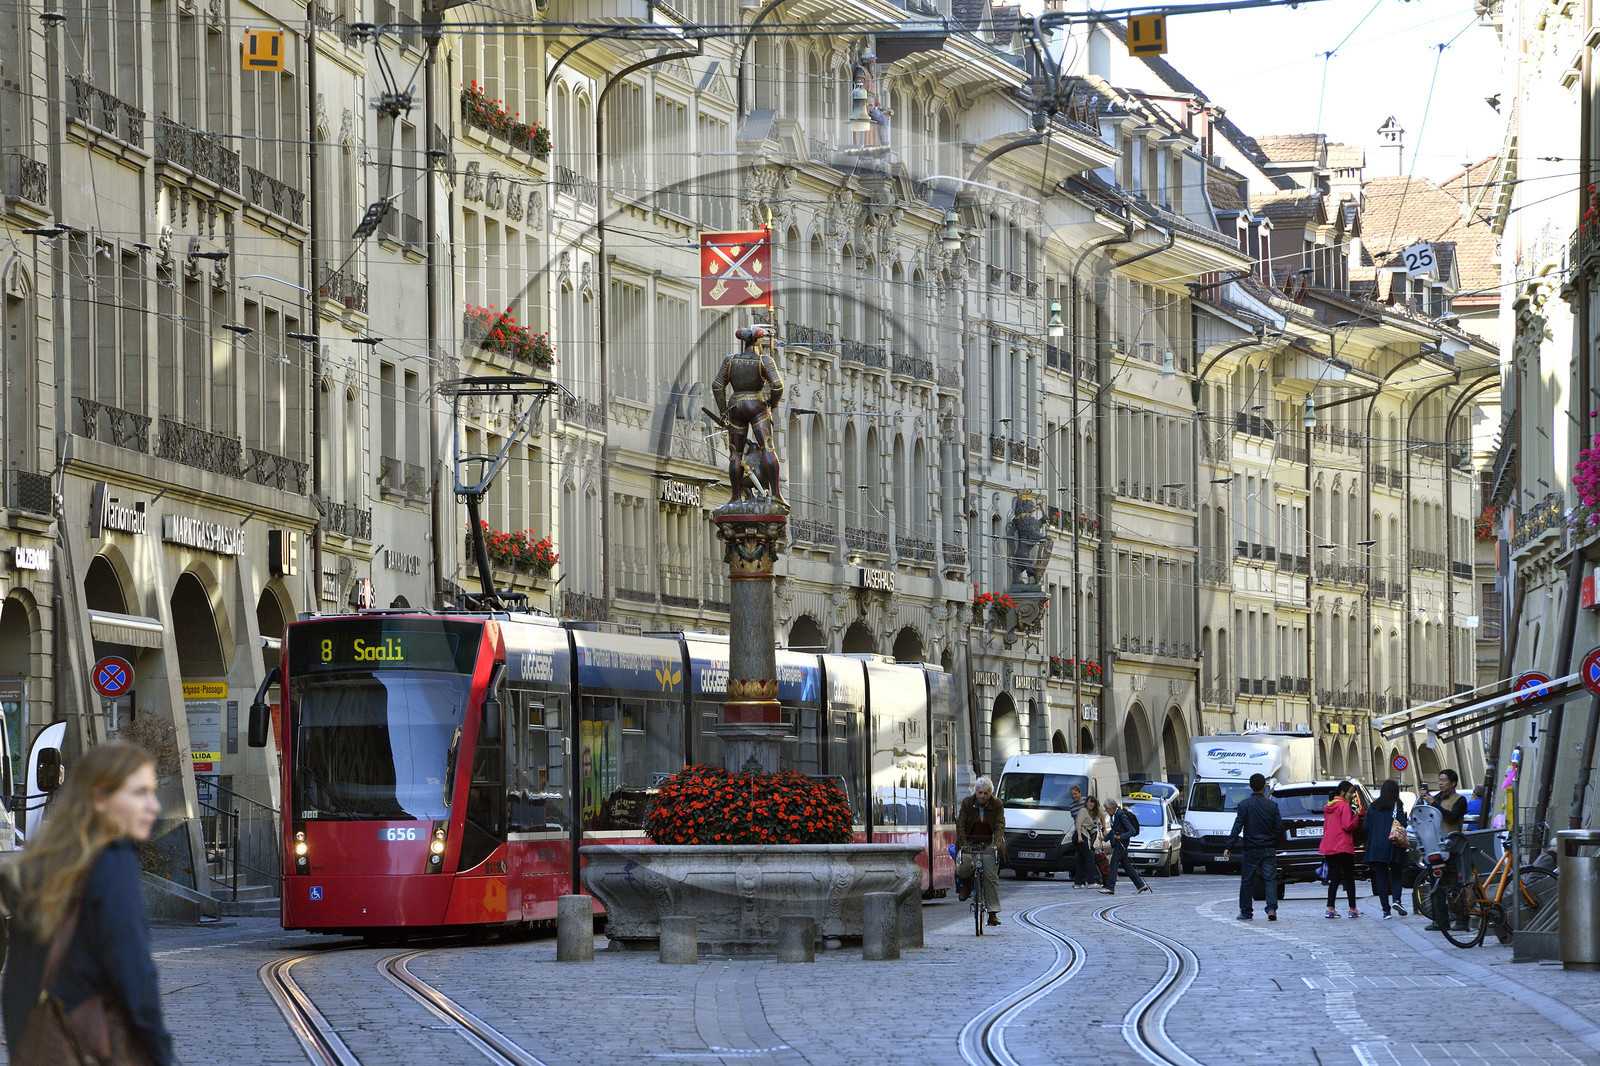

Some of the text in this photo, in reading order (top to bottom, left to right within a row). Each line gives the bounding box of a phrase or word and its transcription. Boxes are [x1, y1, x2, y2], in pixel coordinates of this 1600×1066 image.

[1406, 248, 1433, 272] 25
[664, 480, 700, 507] KAISERHAUS
[100, 482, 147, 535] Marionnaud
[173, 514, 246, 556] MARKTGASS-PASSAGE
[863, 568, 895, 592] KAISERHAUS
[321, 638, 404, 661] 8 Saali
[183, 684, 224, 695] ktgass-Passage
[386, 827, 416, 841] 656
